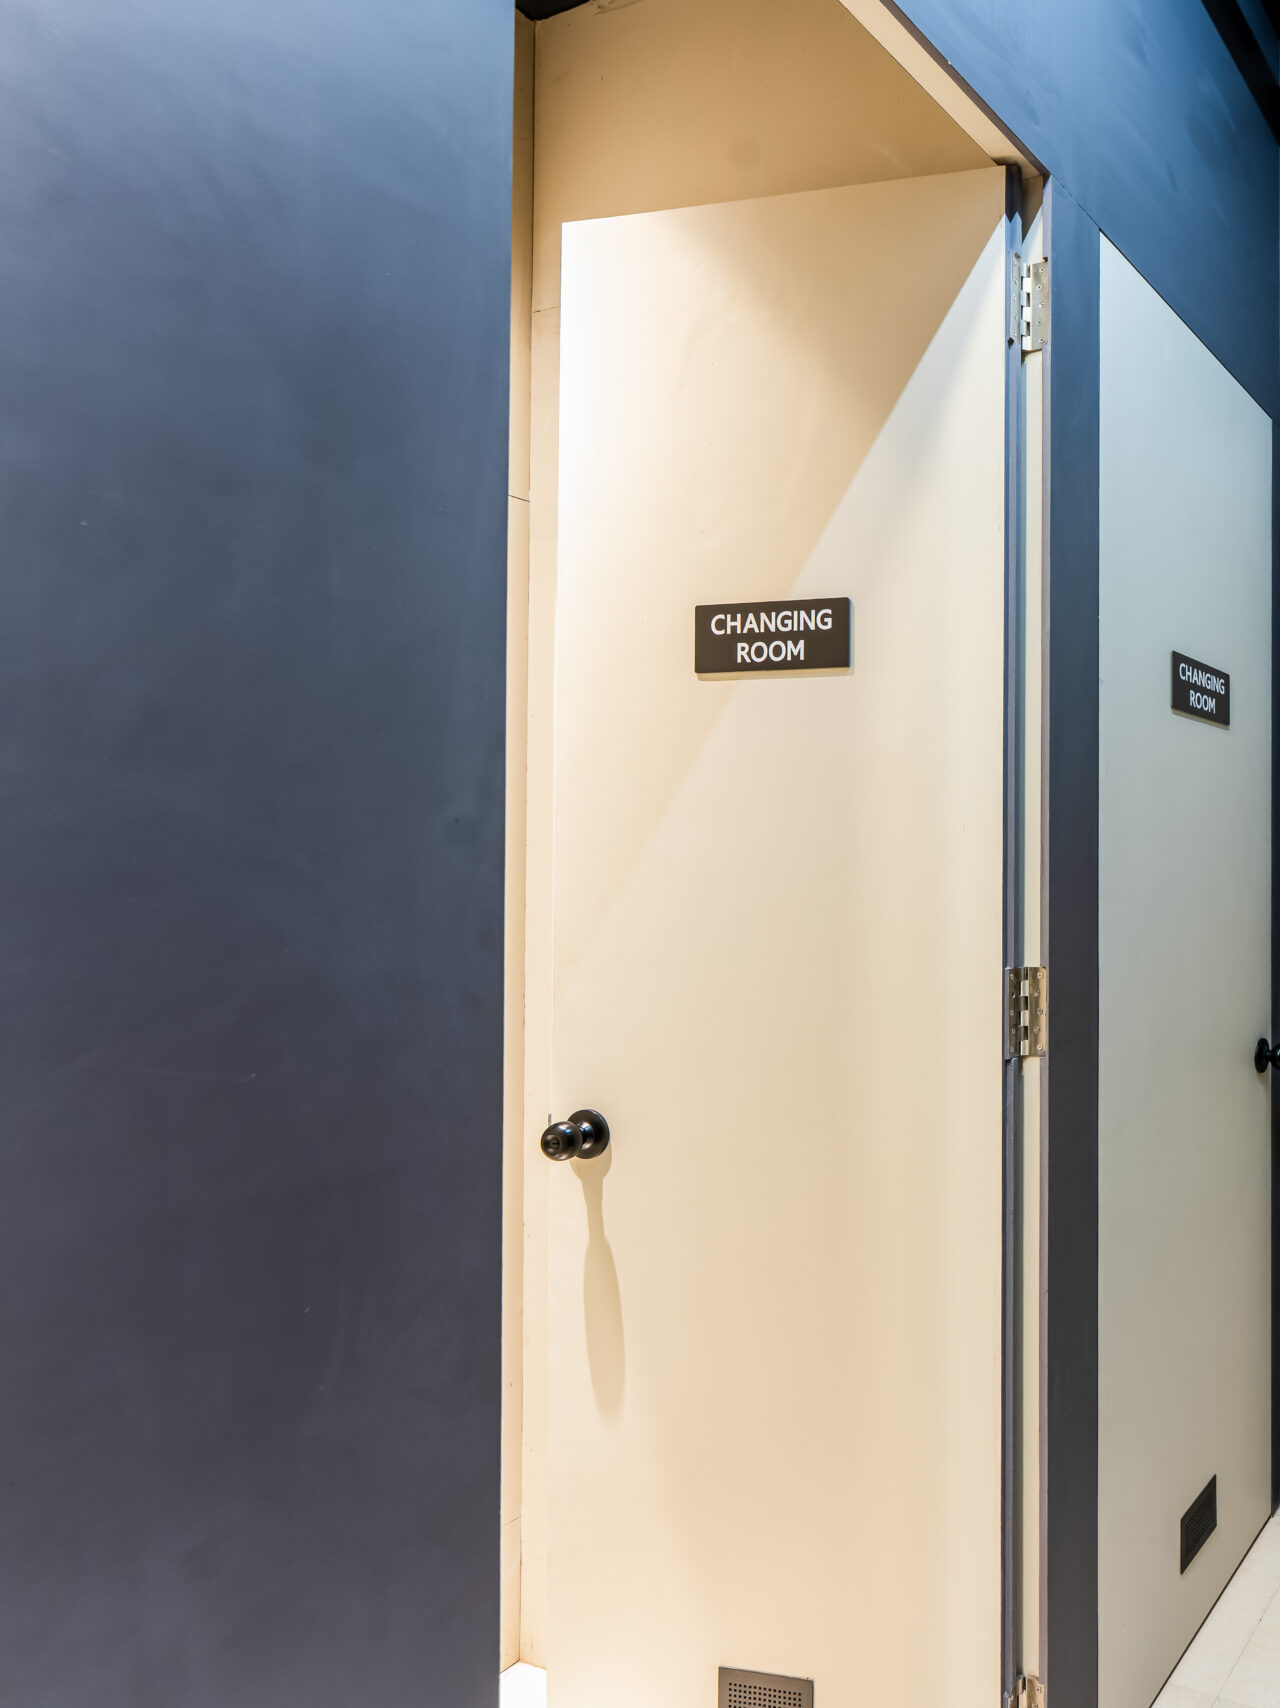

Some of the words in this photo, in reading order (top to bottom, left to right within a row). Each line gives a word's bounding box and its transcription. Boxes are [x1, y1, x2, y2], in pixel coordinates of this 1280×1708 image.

[710, 608, 833, 636] CHANGING
[736, 639, 805, 664] ROOM
[1179, 662, 1225, 695] CHANGING
[1189, 689, 1216, 714] ROOM
